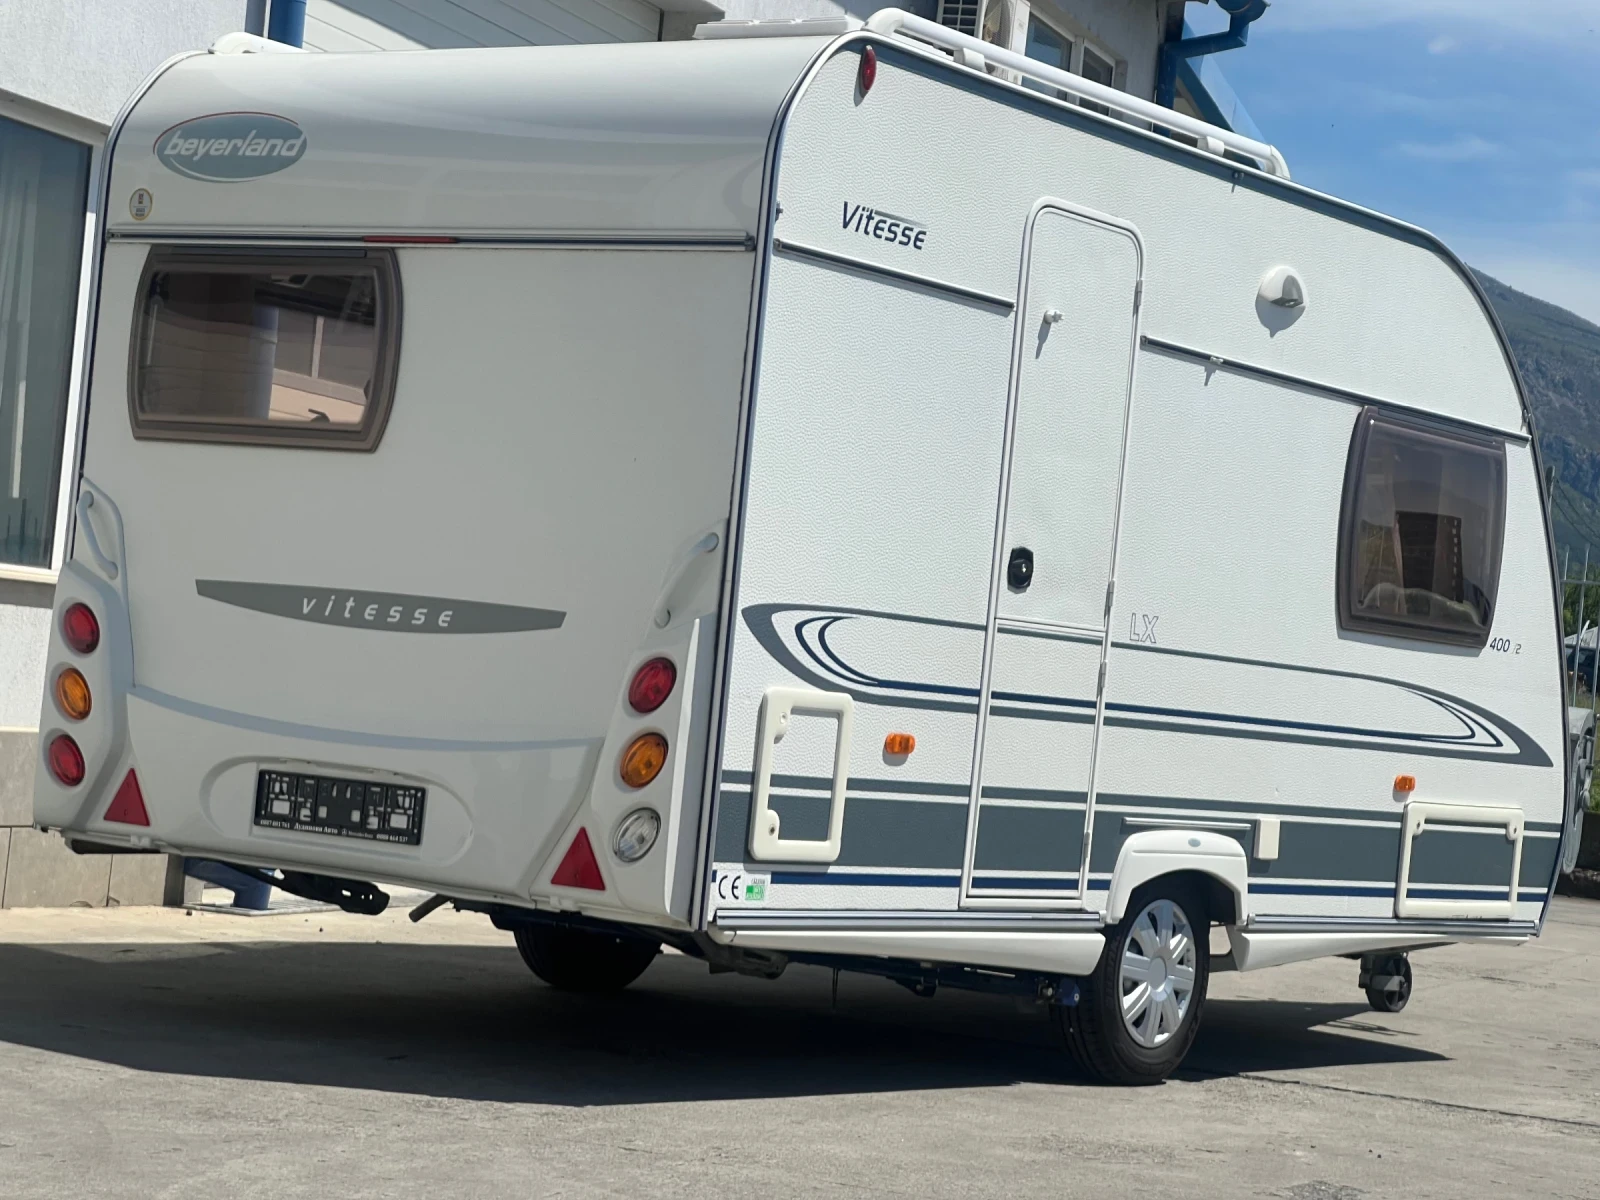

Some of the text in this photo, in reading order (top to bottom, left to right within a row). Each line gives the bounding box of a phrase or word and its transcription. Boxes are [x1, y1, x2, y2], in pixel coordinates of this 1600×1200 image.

[163, 129, 306, 161] beyerland
[842, 200, 927, 250] Vitesse
[302, 594, 453, 627] vitesse
[1129, 612, 1159, 644] LX
[1489, 637, 1511, 653] 400
